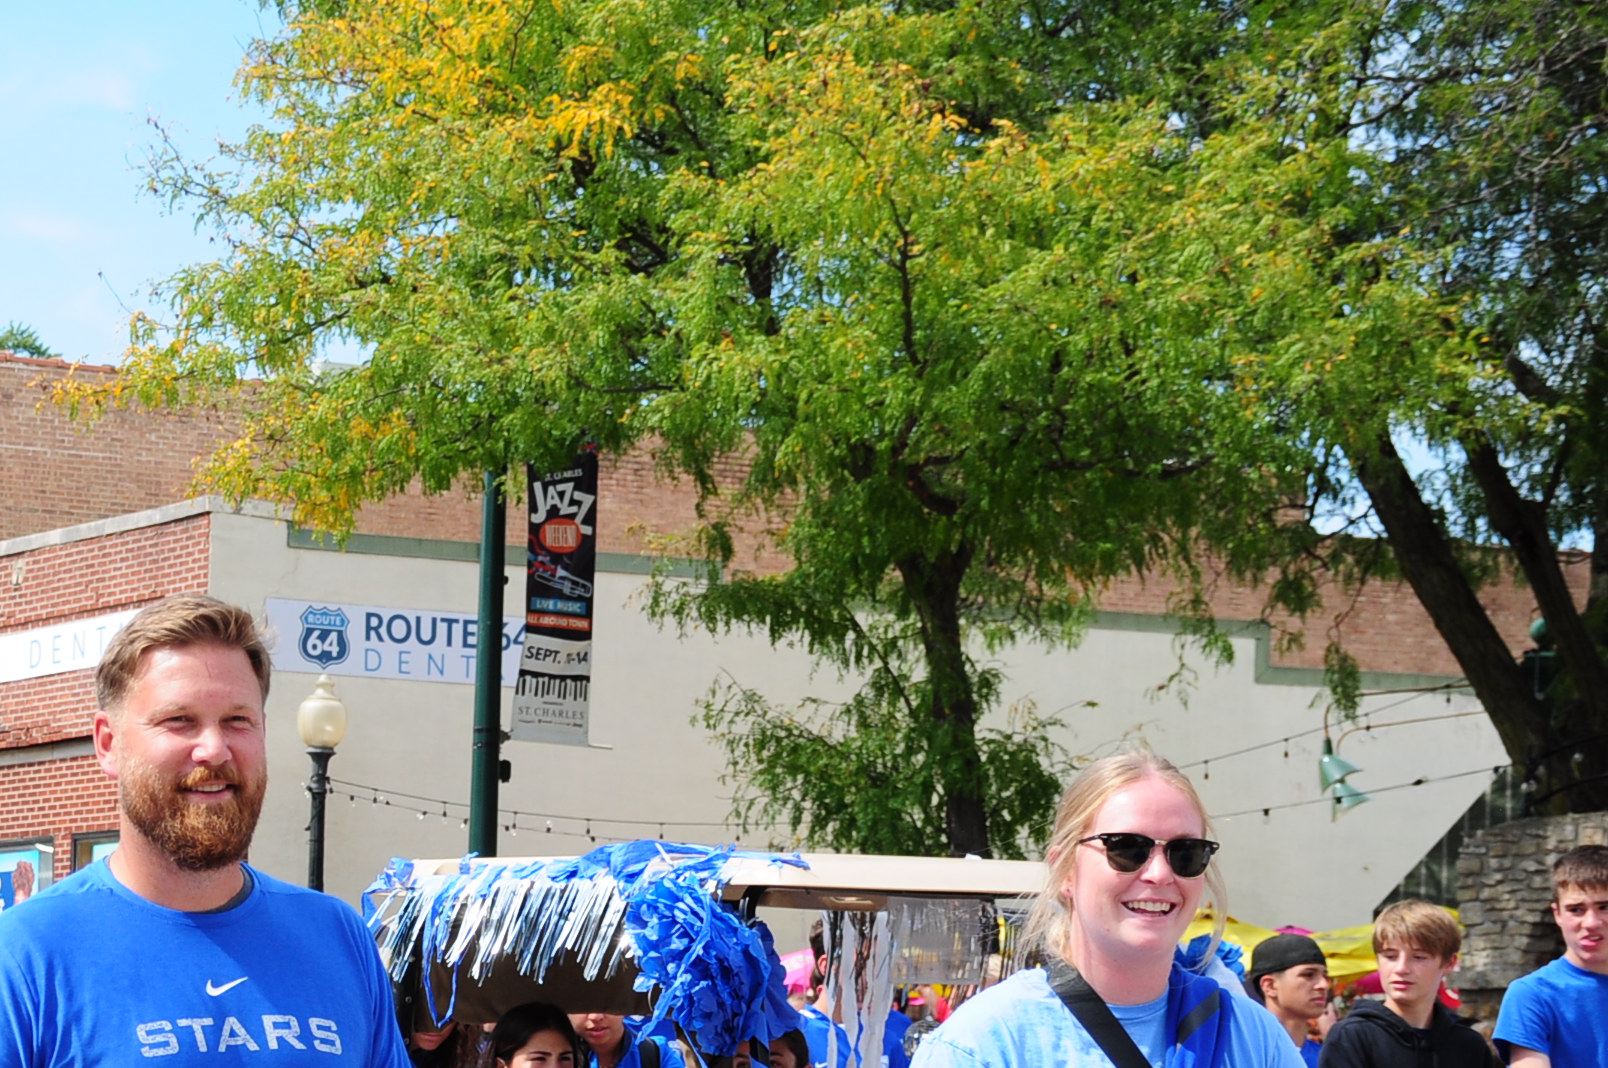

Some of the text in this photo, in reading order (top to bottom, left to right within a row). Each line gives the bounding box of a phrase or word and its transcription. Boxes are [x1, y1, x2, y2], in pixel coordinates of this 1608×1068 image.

[530, 481, 596, 536] JAZZ
[306, 613, 342, 626] ROUTE
[536, 599, 554, 610] LIVE
[306, 629, 340, 658] 64
[365, 611, 479, 649] ROUTE
[29, 623, 118, 669] DENT
[525, 645, 561, 664] SEPT.
[364, 648, 498, 679] DENT
[533, 707, 585, 720] CHARLES
[135, 1014, 343, 1058] STARS
